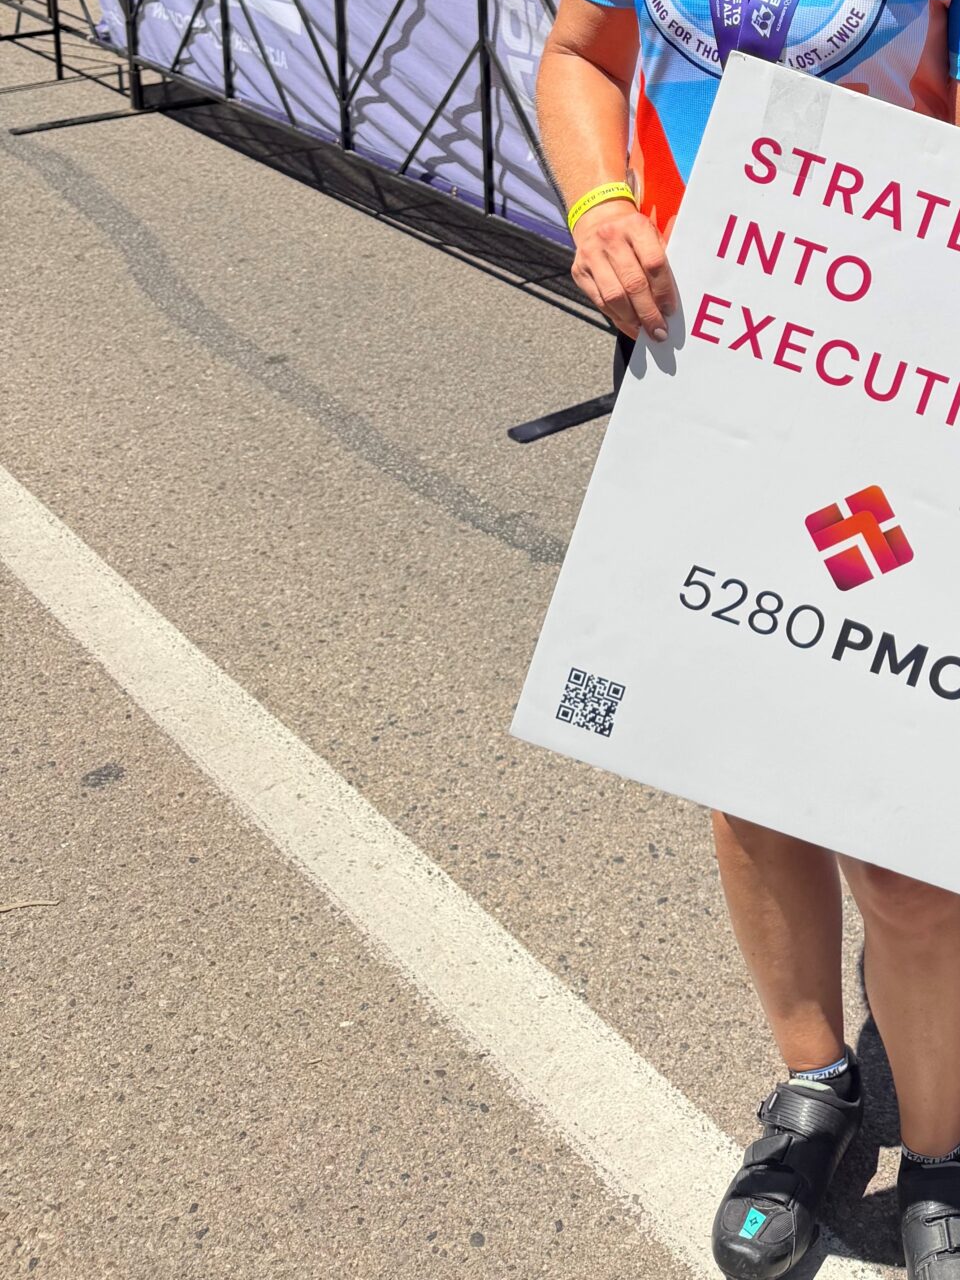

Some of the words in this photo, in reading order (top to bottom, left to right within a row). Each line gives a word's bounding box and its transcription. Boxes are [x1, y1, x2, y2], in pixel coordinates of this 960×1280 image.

[724, 4, 732, 27] ALZ
[732, 6, 741, 25] TO
[667, 19, 692, 45] FOR
[695, 39, 720, 63] THO
[716, 214, 872, 302] INTO
